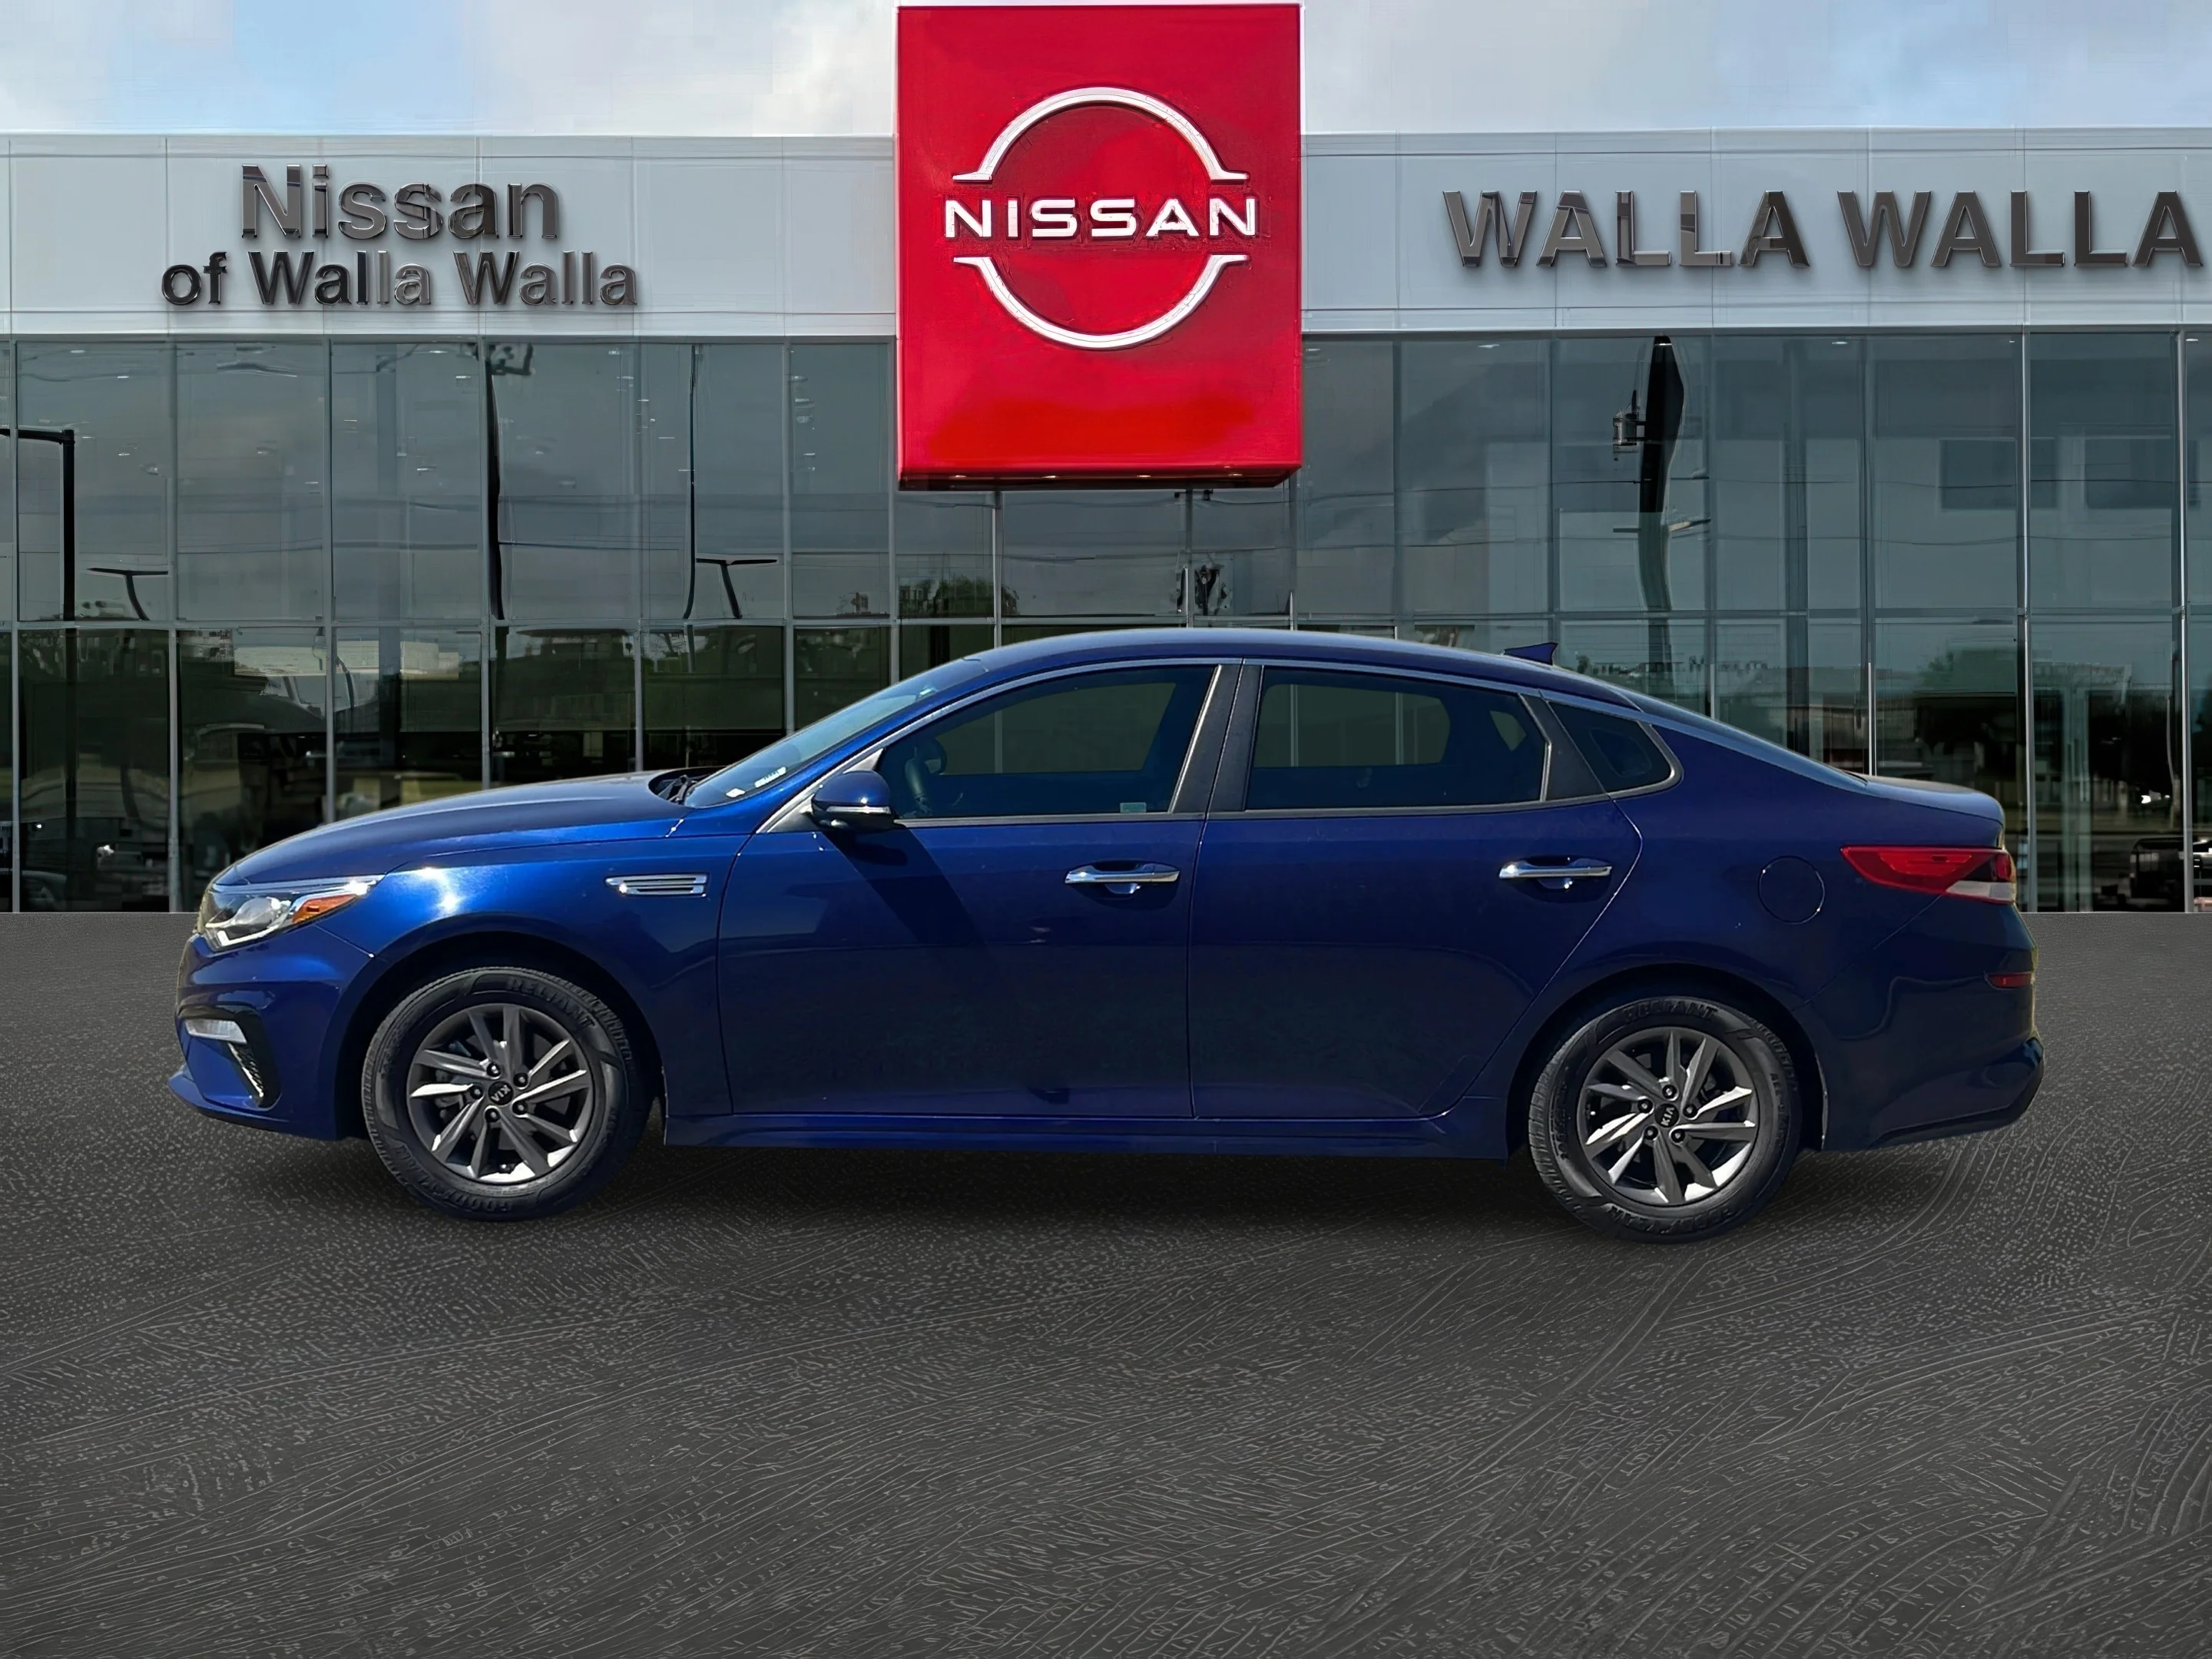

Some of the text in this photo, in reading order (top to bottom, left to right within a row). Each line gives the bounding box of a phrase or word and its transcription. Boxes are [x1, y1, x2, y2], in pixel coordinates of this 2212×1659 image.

[240, 163, 559, 240] Nissan
[945, 197, 1256, 238] NISSAN
[1442, 189, 2204, 269] WALLA WALLA
[161, 250, 638, 306] of Walla Walla
[1659, 1107, 1676, 1128] KIA
